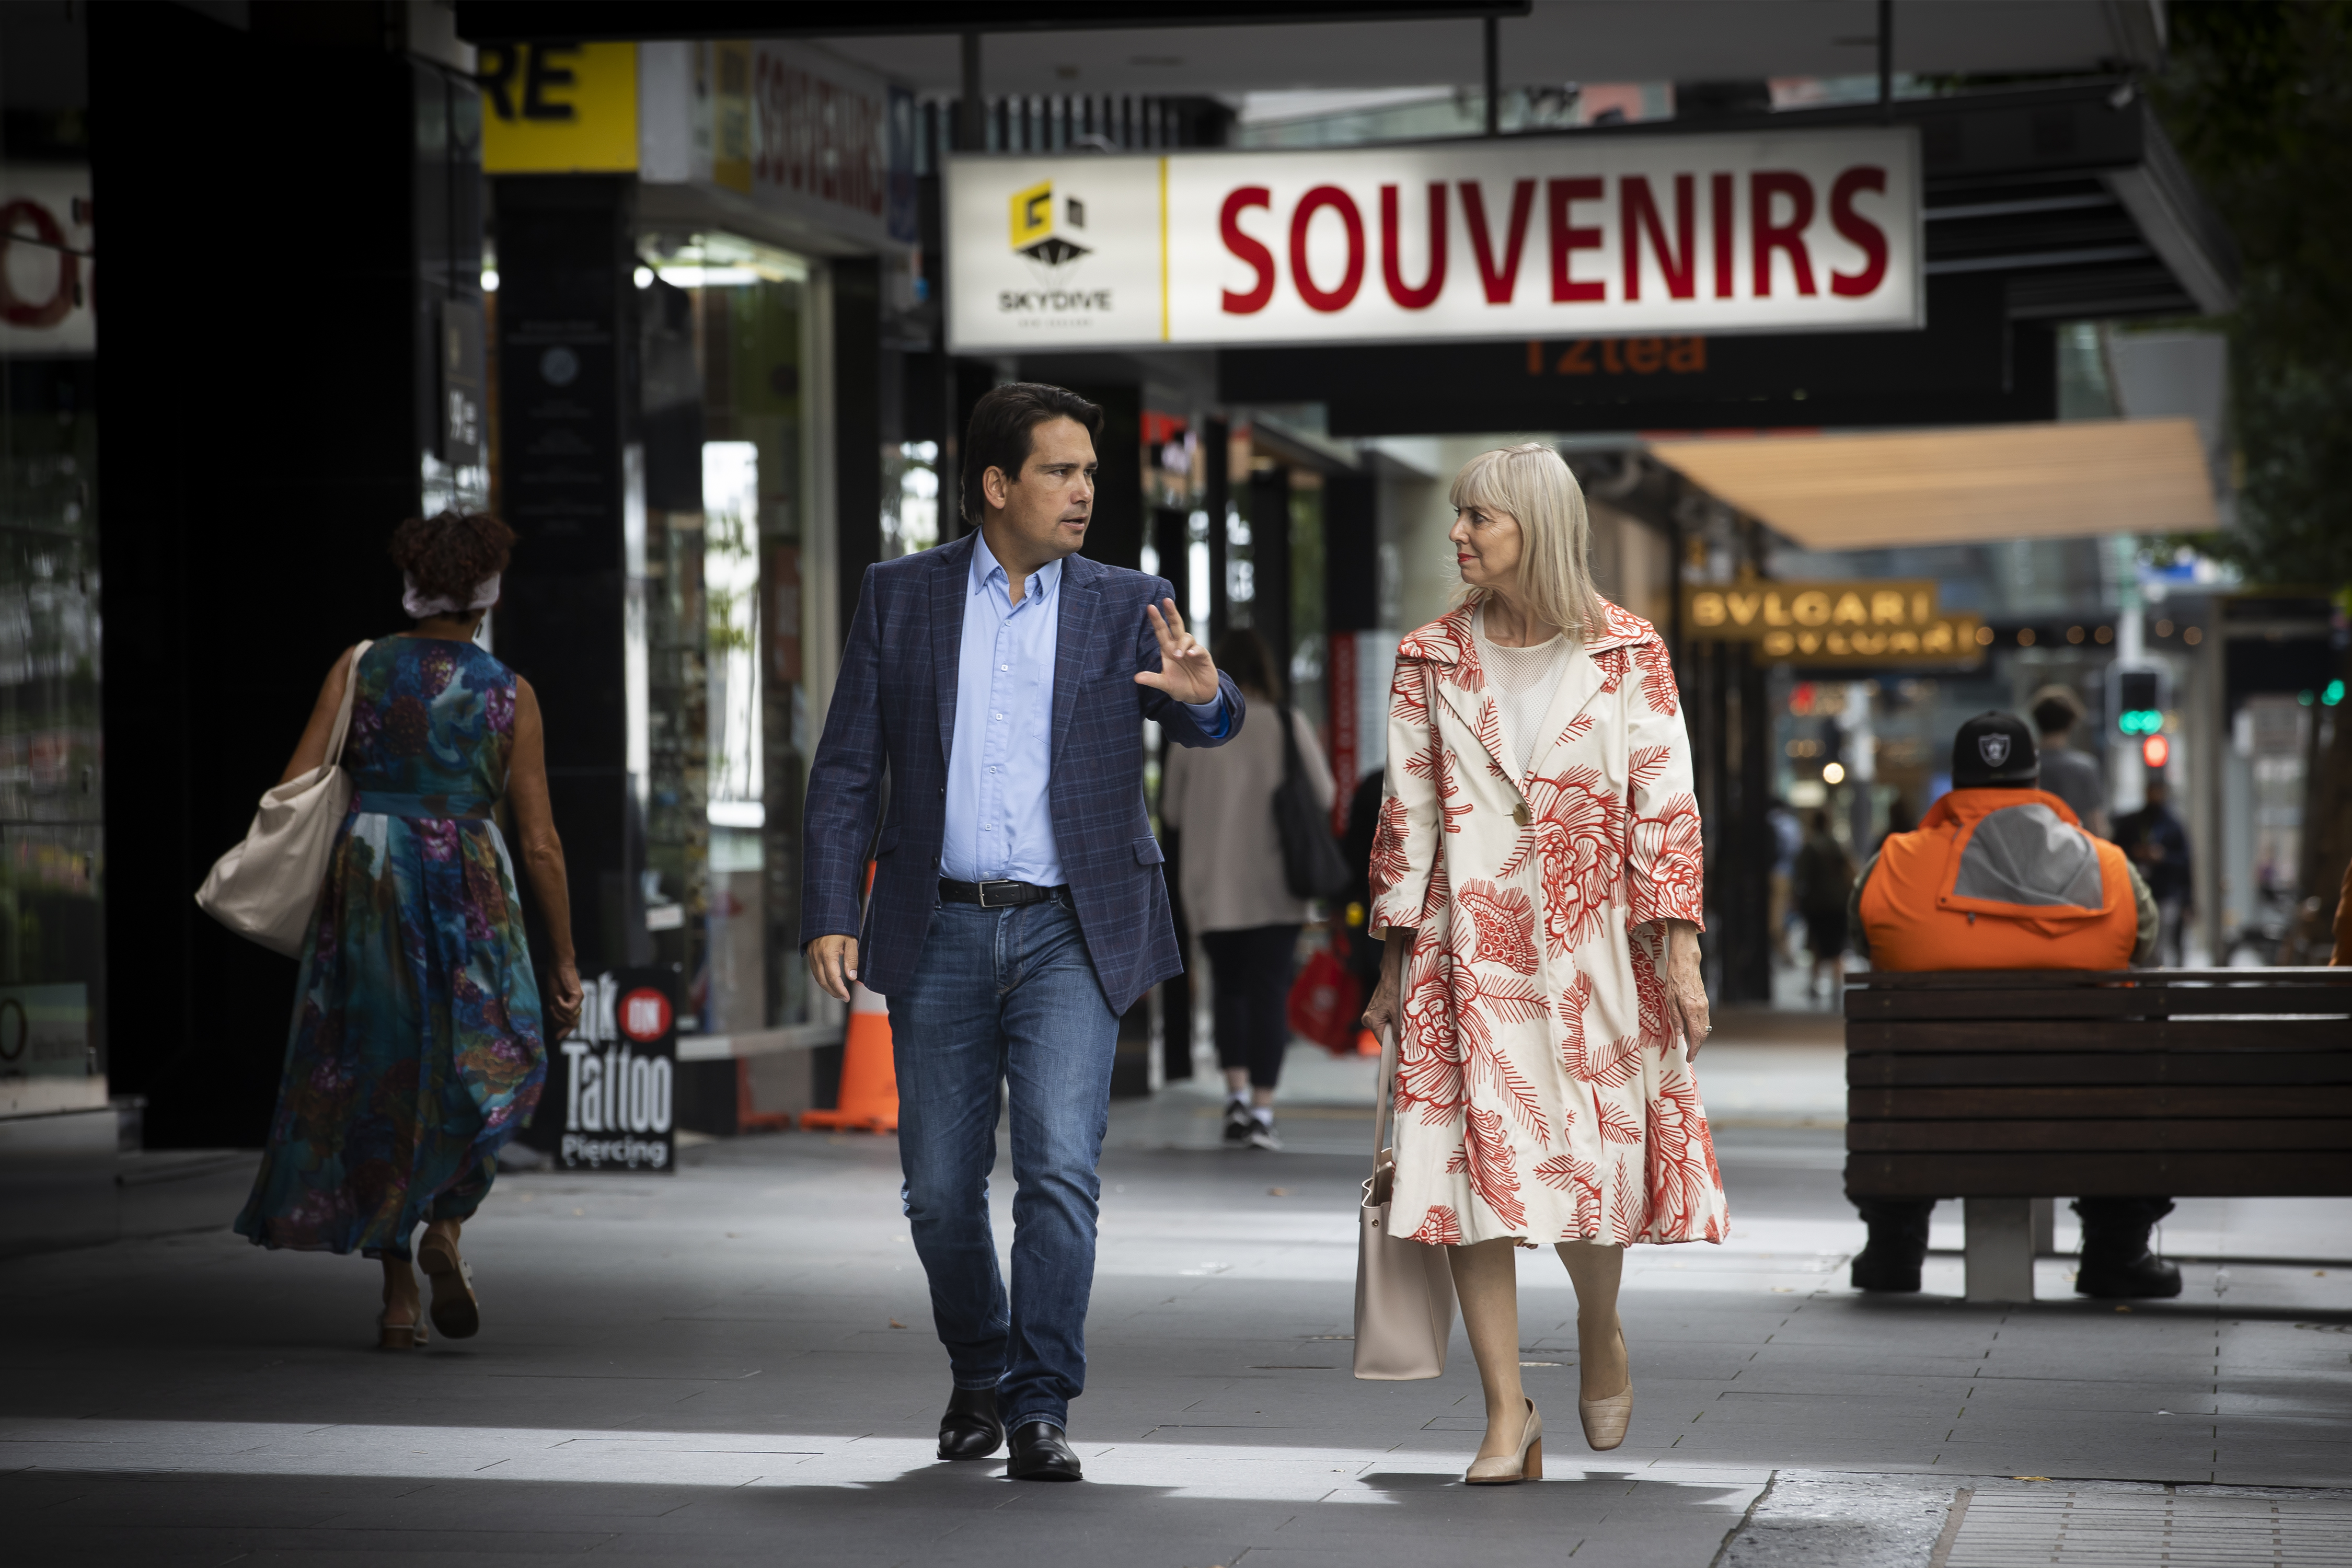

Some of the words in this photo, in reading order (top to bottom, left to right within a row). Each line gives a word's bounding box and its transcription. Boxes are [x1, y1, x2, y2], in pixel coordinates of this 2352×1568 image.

[1219, 164, 1890, 316] SOUVENIRS
[998, 289, 1113, 313] SKYDIVE
[560, 1040, 673, 1133] Tattoo
[561, 1133, 668, 1168] Piercing
